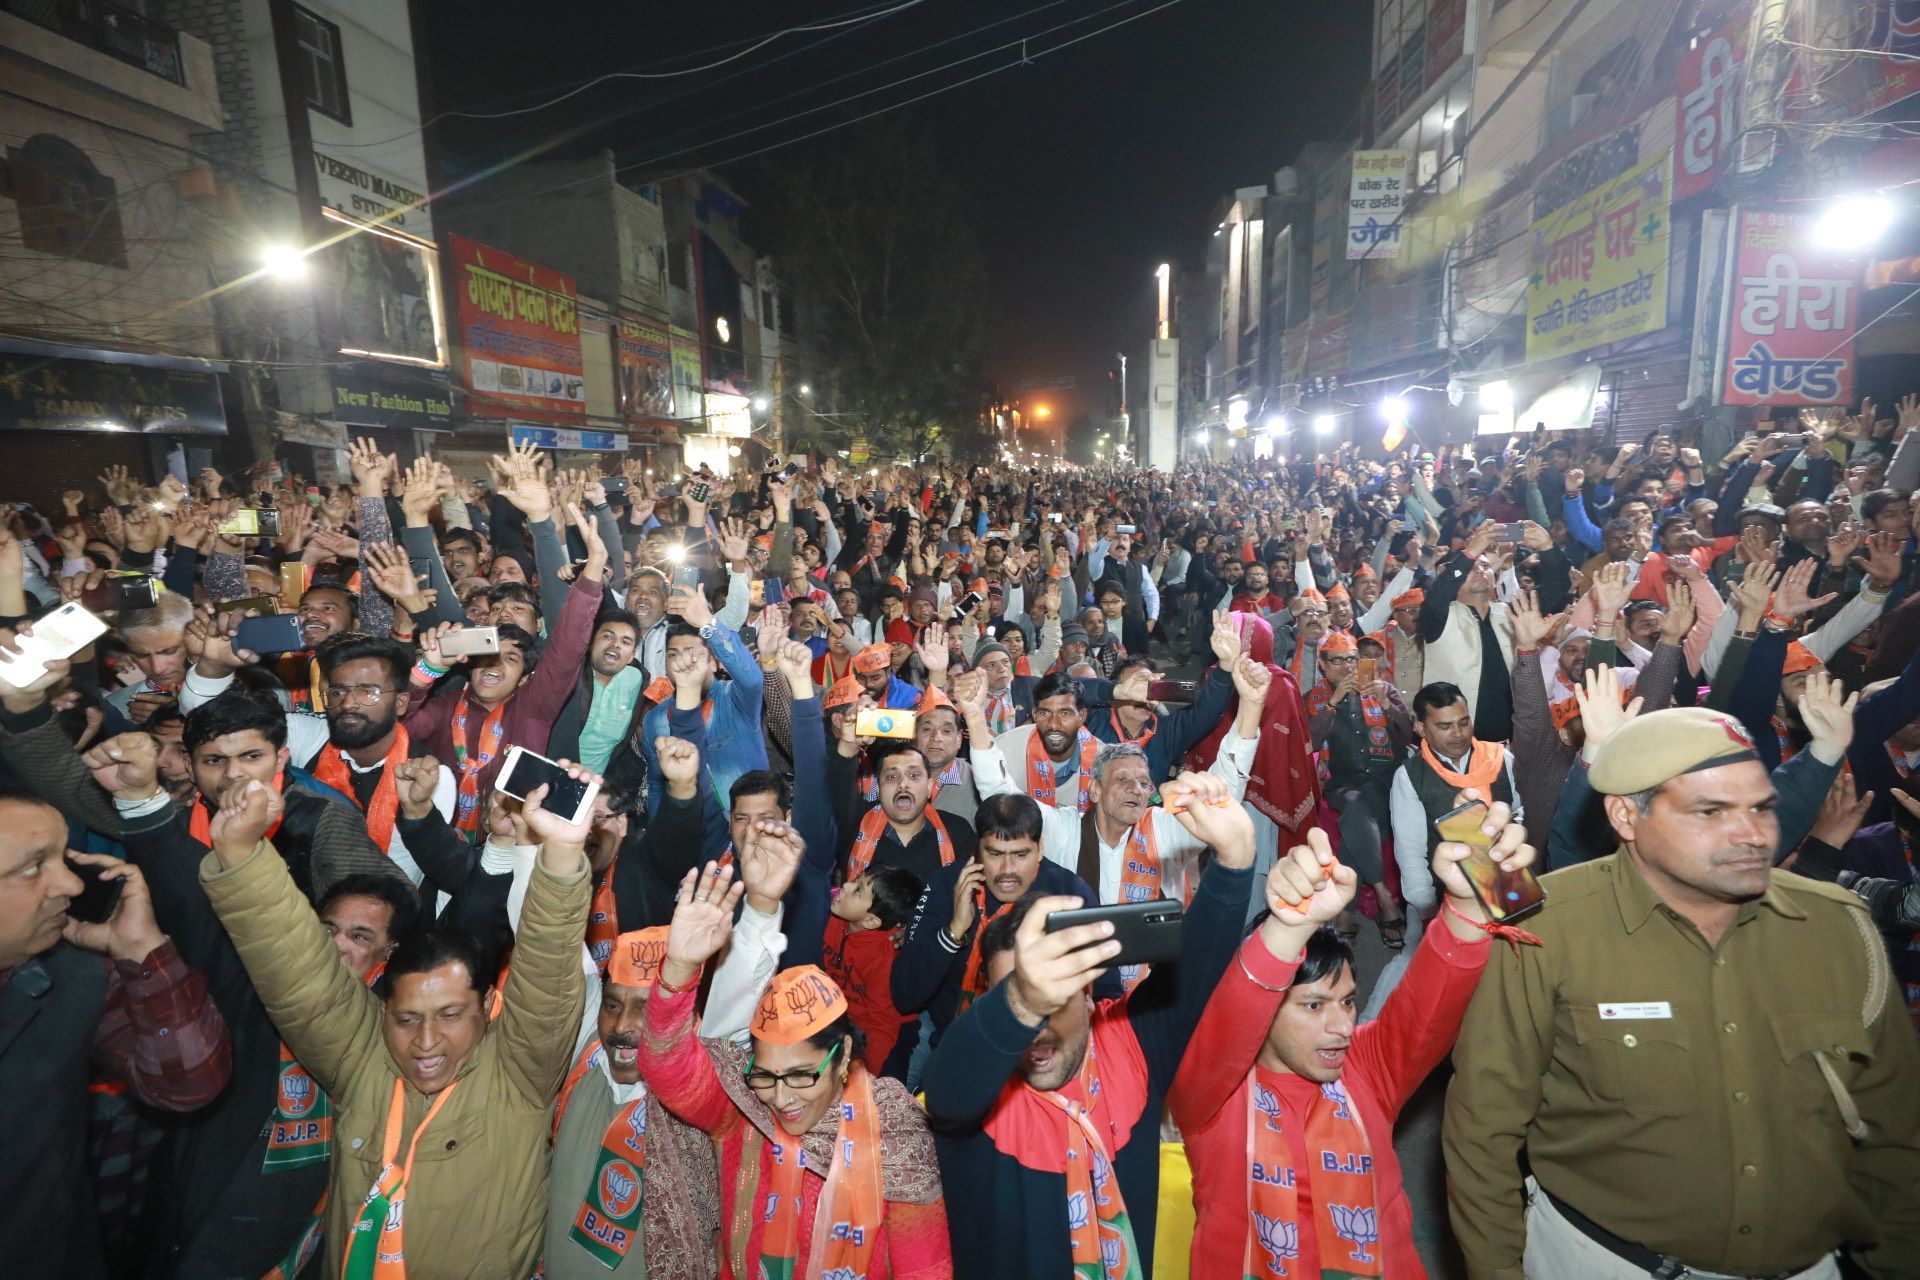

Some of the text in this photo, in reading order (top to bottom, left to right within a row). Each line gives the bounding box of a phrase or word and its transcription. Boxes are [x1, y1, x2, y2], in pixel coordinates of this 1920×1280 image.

[313, 152, 428, 213] VEENU MAKEUP
[1386, 177, 1401, 190] रेट
[351, 194, 405, 225] STUDIO
[1351, 199, 1366, 209] पर
[1747, 213, 1764, 226] M.
[1349, 216, 1404, 244] जैन
[1546, 197, 1641, 287] दवाई घर
[465, 249, 514, 321] गोयल
[1740, 253, 1853, 336] हीरा
[1733, 339, 1848, 402] बैण्ड
[336, 387, 451, 415] New Fashion Hub
[275, 1121, 320, 1145] B.J.P.
[583, 1209, 627, 1250] B.J.P.
